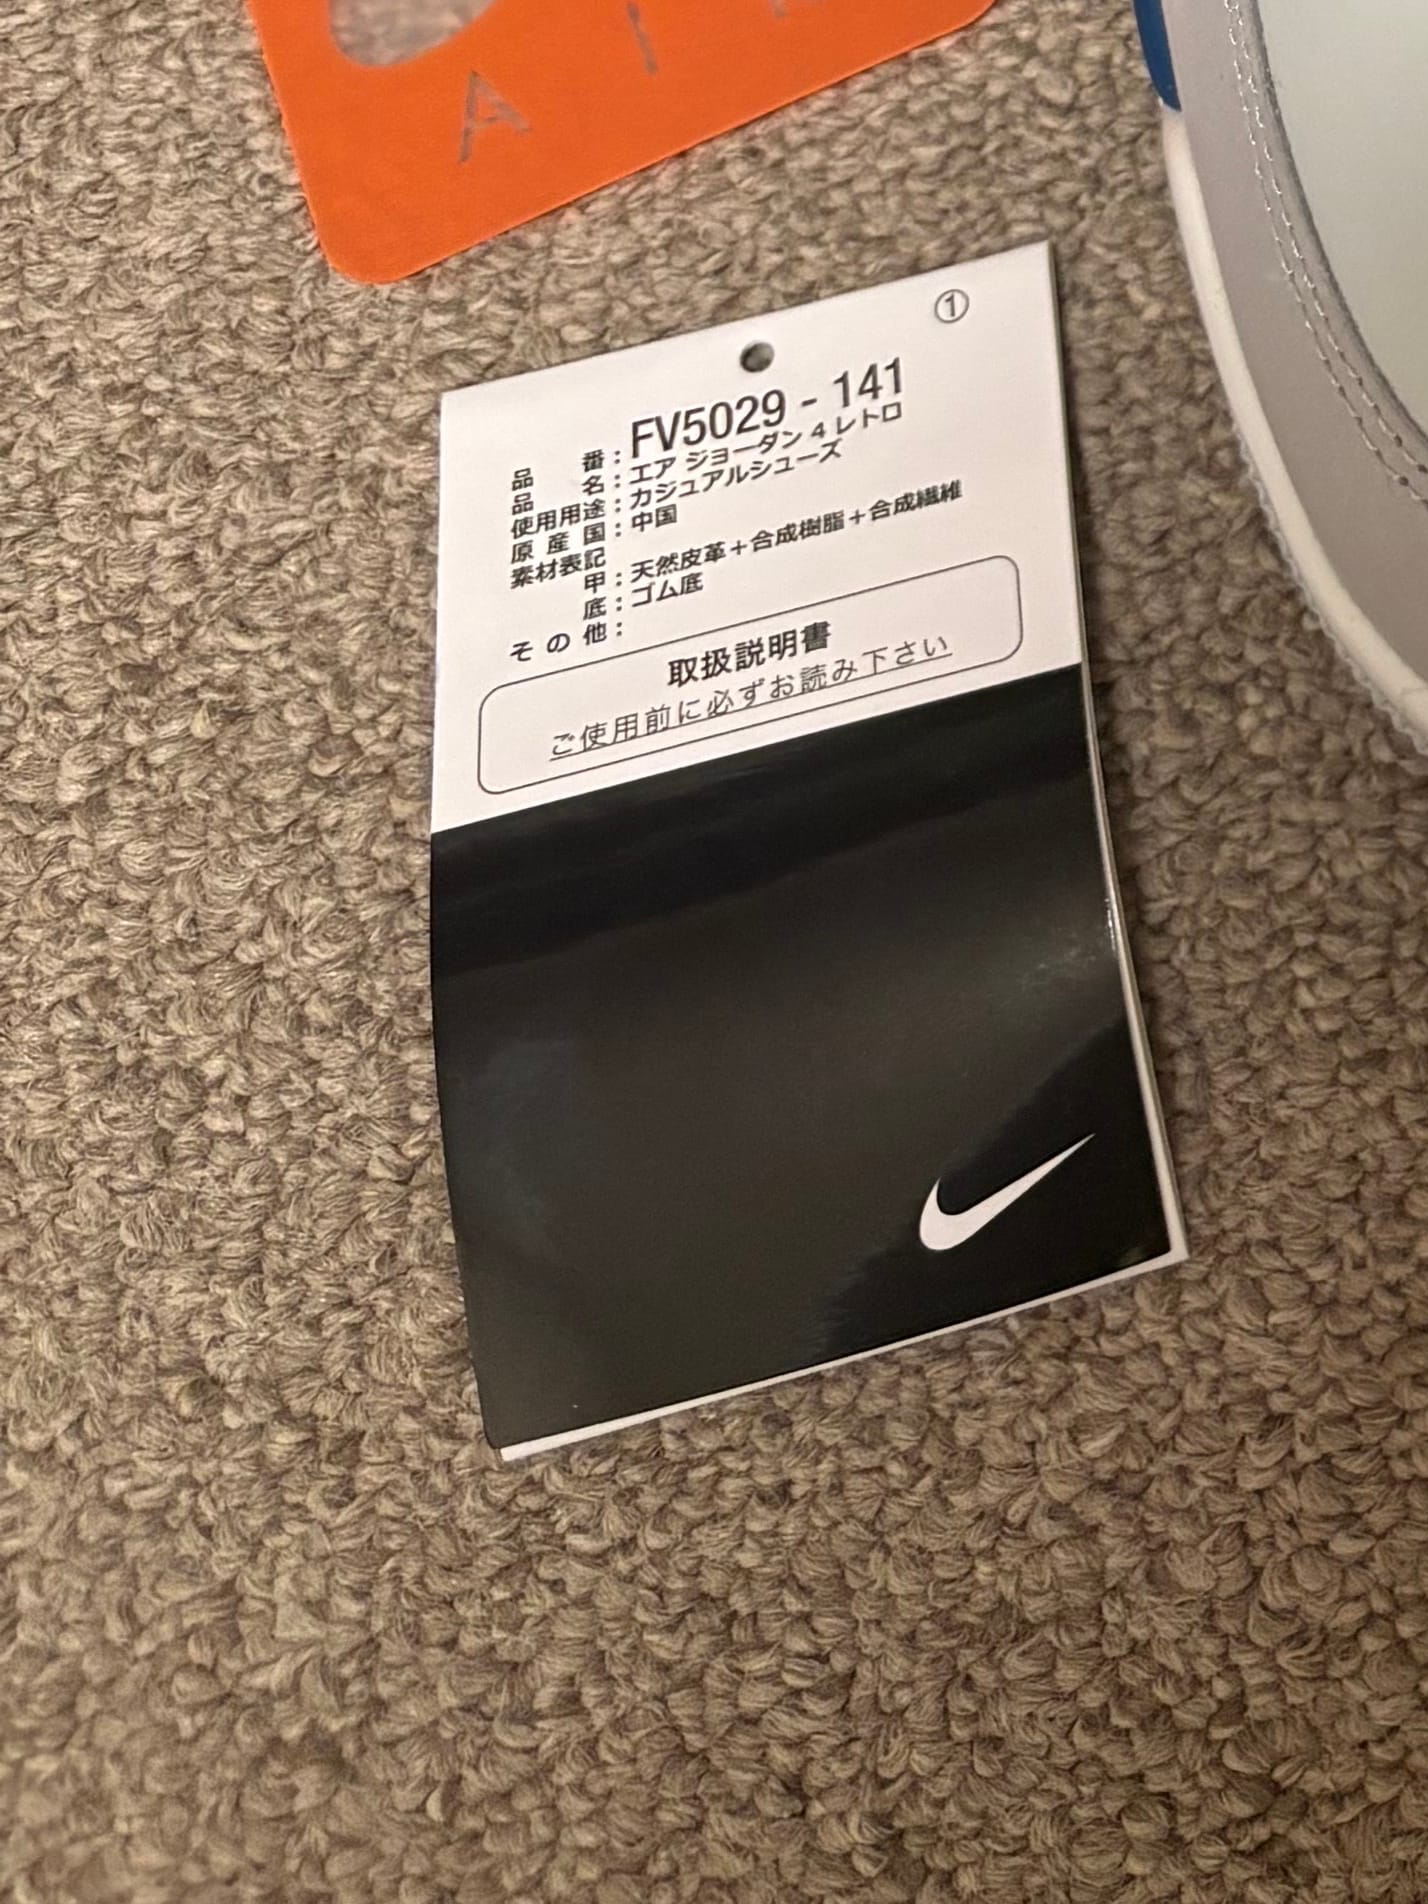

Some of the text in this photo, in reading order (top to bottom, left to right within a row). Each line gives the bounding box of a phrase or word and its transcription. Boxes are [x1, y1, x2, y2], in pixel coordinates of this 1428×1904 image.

[629, 438, 843, 511] カジュアルシューズ
[630, 503, 678, 533] 中国
[510, 547, 606, 590] 素材表記
[631, 572, 703, 608] ゴム底
[667, 621, 832, 689] 取扱説明書
[551, 635, 949, 757] ご使用前に必ずお読み下さい
